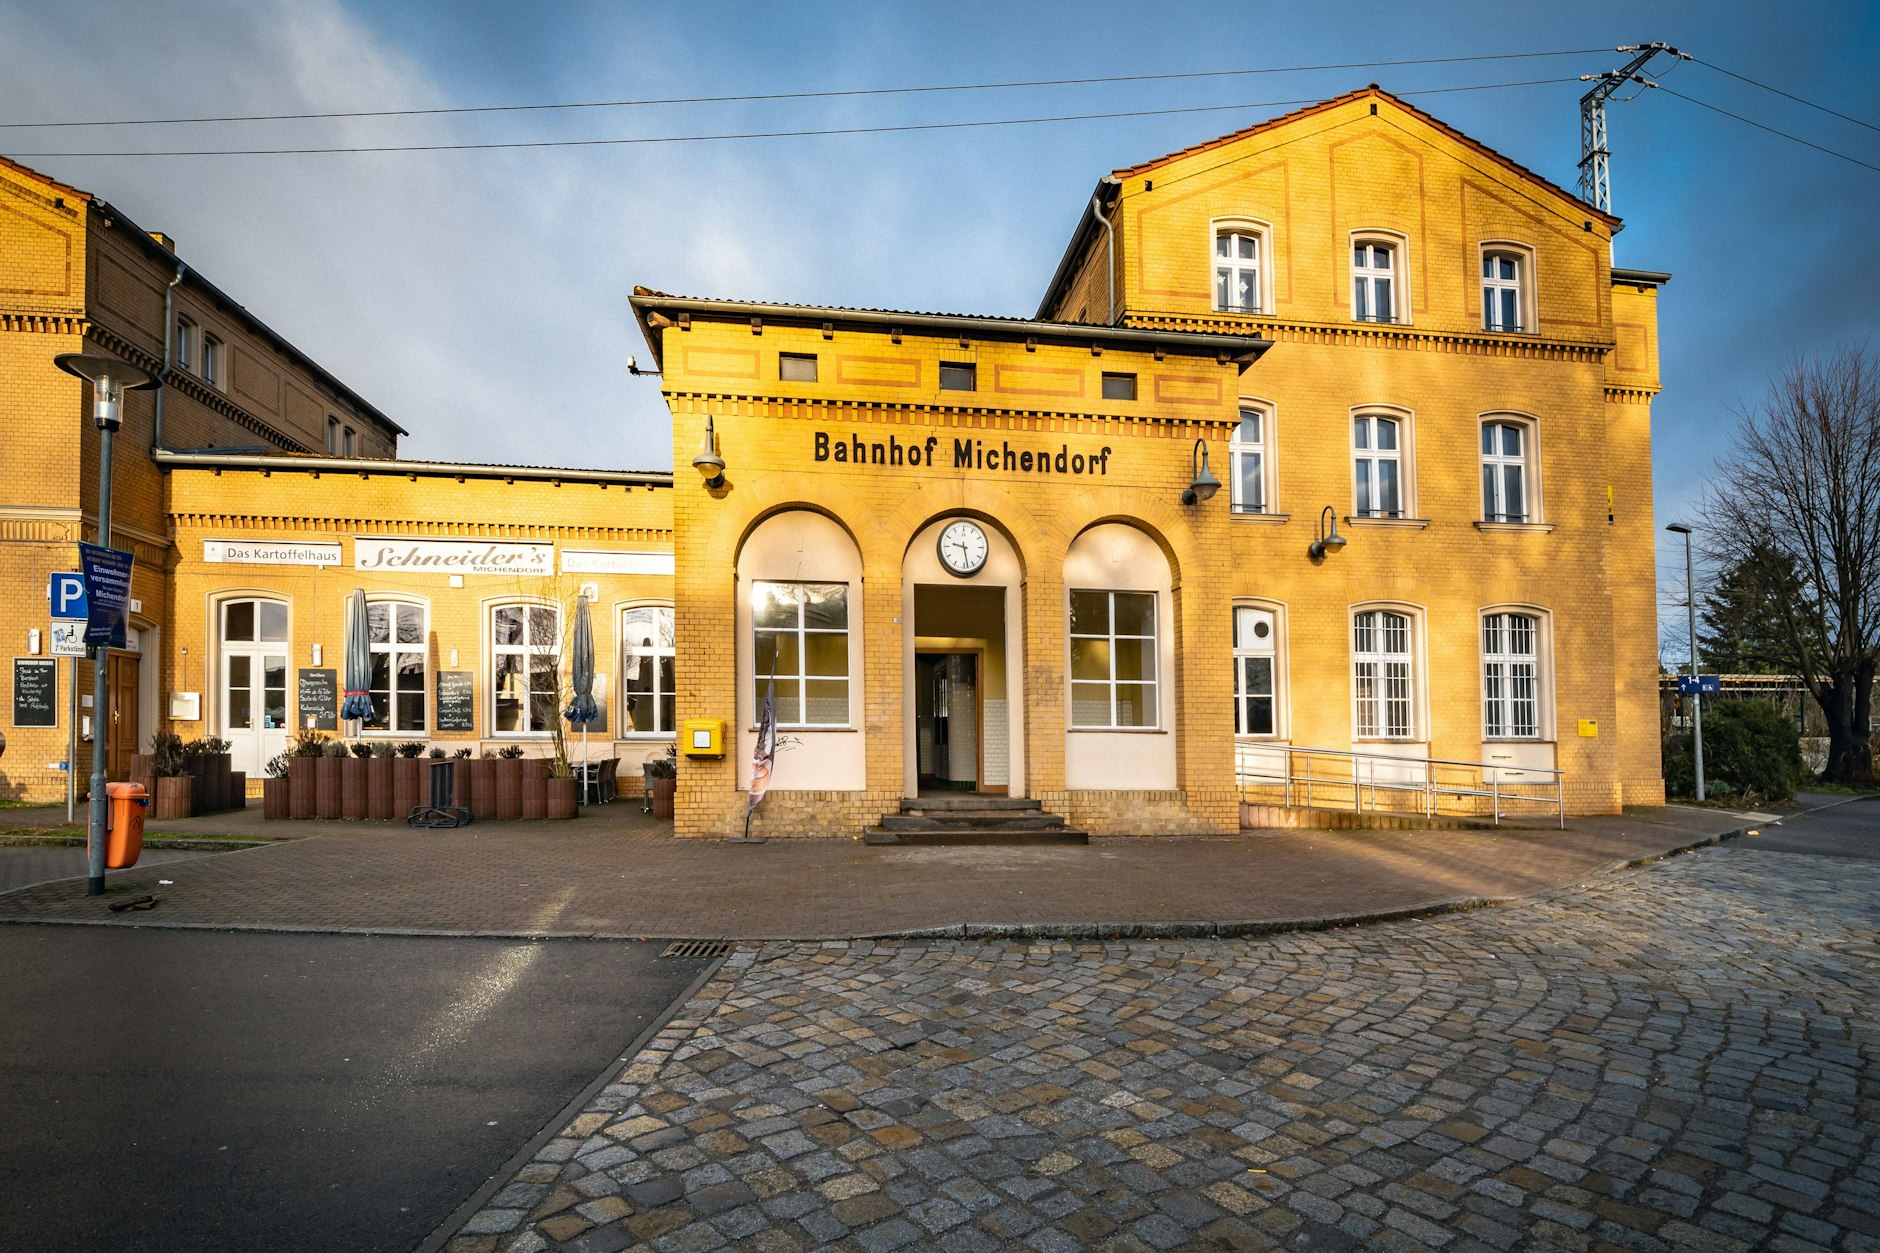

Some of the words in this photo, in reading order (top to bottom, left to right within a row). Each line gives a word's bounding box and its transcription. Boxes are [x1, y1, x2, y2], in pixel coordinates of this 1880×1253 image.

[814, 431, 938, 467] Bahnhof
[953, 438, 1112, 476] Michendorf
[227, 547, 250, 559] Das
[254, 548, 338, 561] Kartoffelhaus
[360, 546, 547, 568] Schneider's
[567, 557, 588, 568] Das
[472, 566, 547, 574] MICHENDORF
[60, 578, 83, 613] P
[60, 644, 85, 653] Parkständ
[1687, 675, 1700, 684] 1-4
